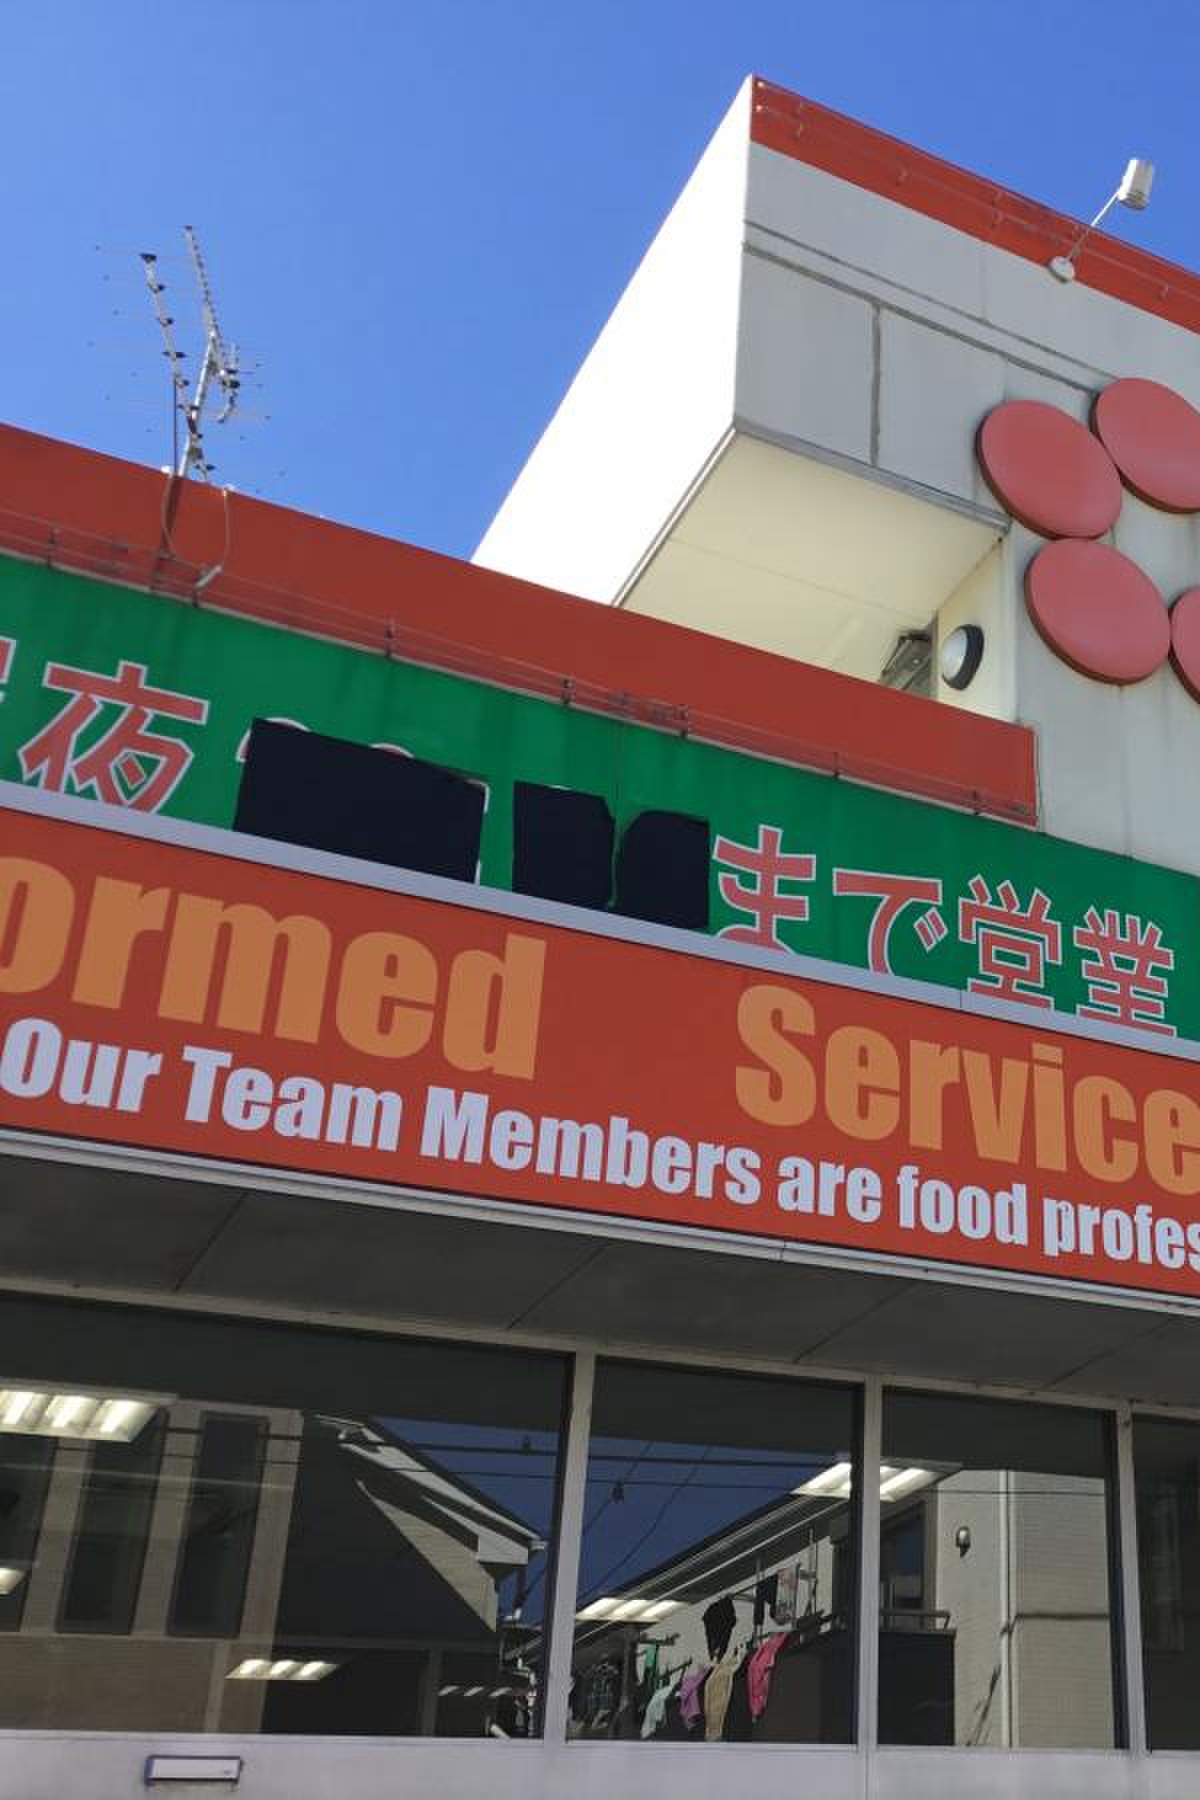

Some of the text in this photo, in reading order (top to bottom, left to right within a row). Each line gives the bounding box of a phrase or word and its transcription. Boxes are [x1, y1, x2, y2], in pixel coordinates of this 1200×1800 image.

[0, 637, 209, 814] 夜
[712, 825, 1177, 1036] まで営業
[0, 1018, 162, 1112] Our
[182, 1046, 402, 1151] Team
[420, 1086, 762, 1203] Members
[778, 1155, 882, 1222] are
[897, 1165, 1028, 1242] food
